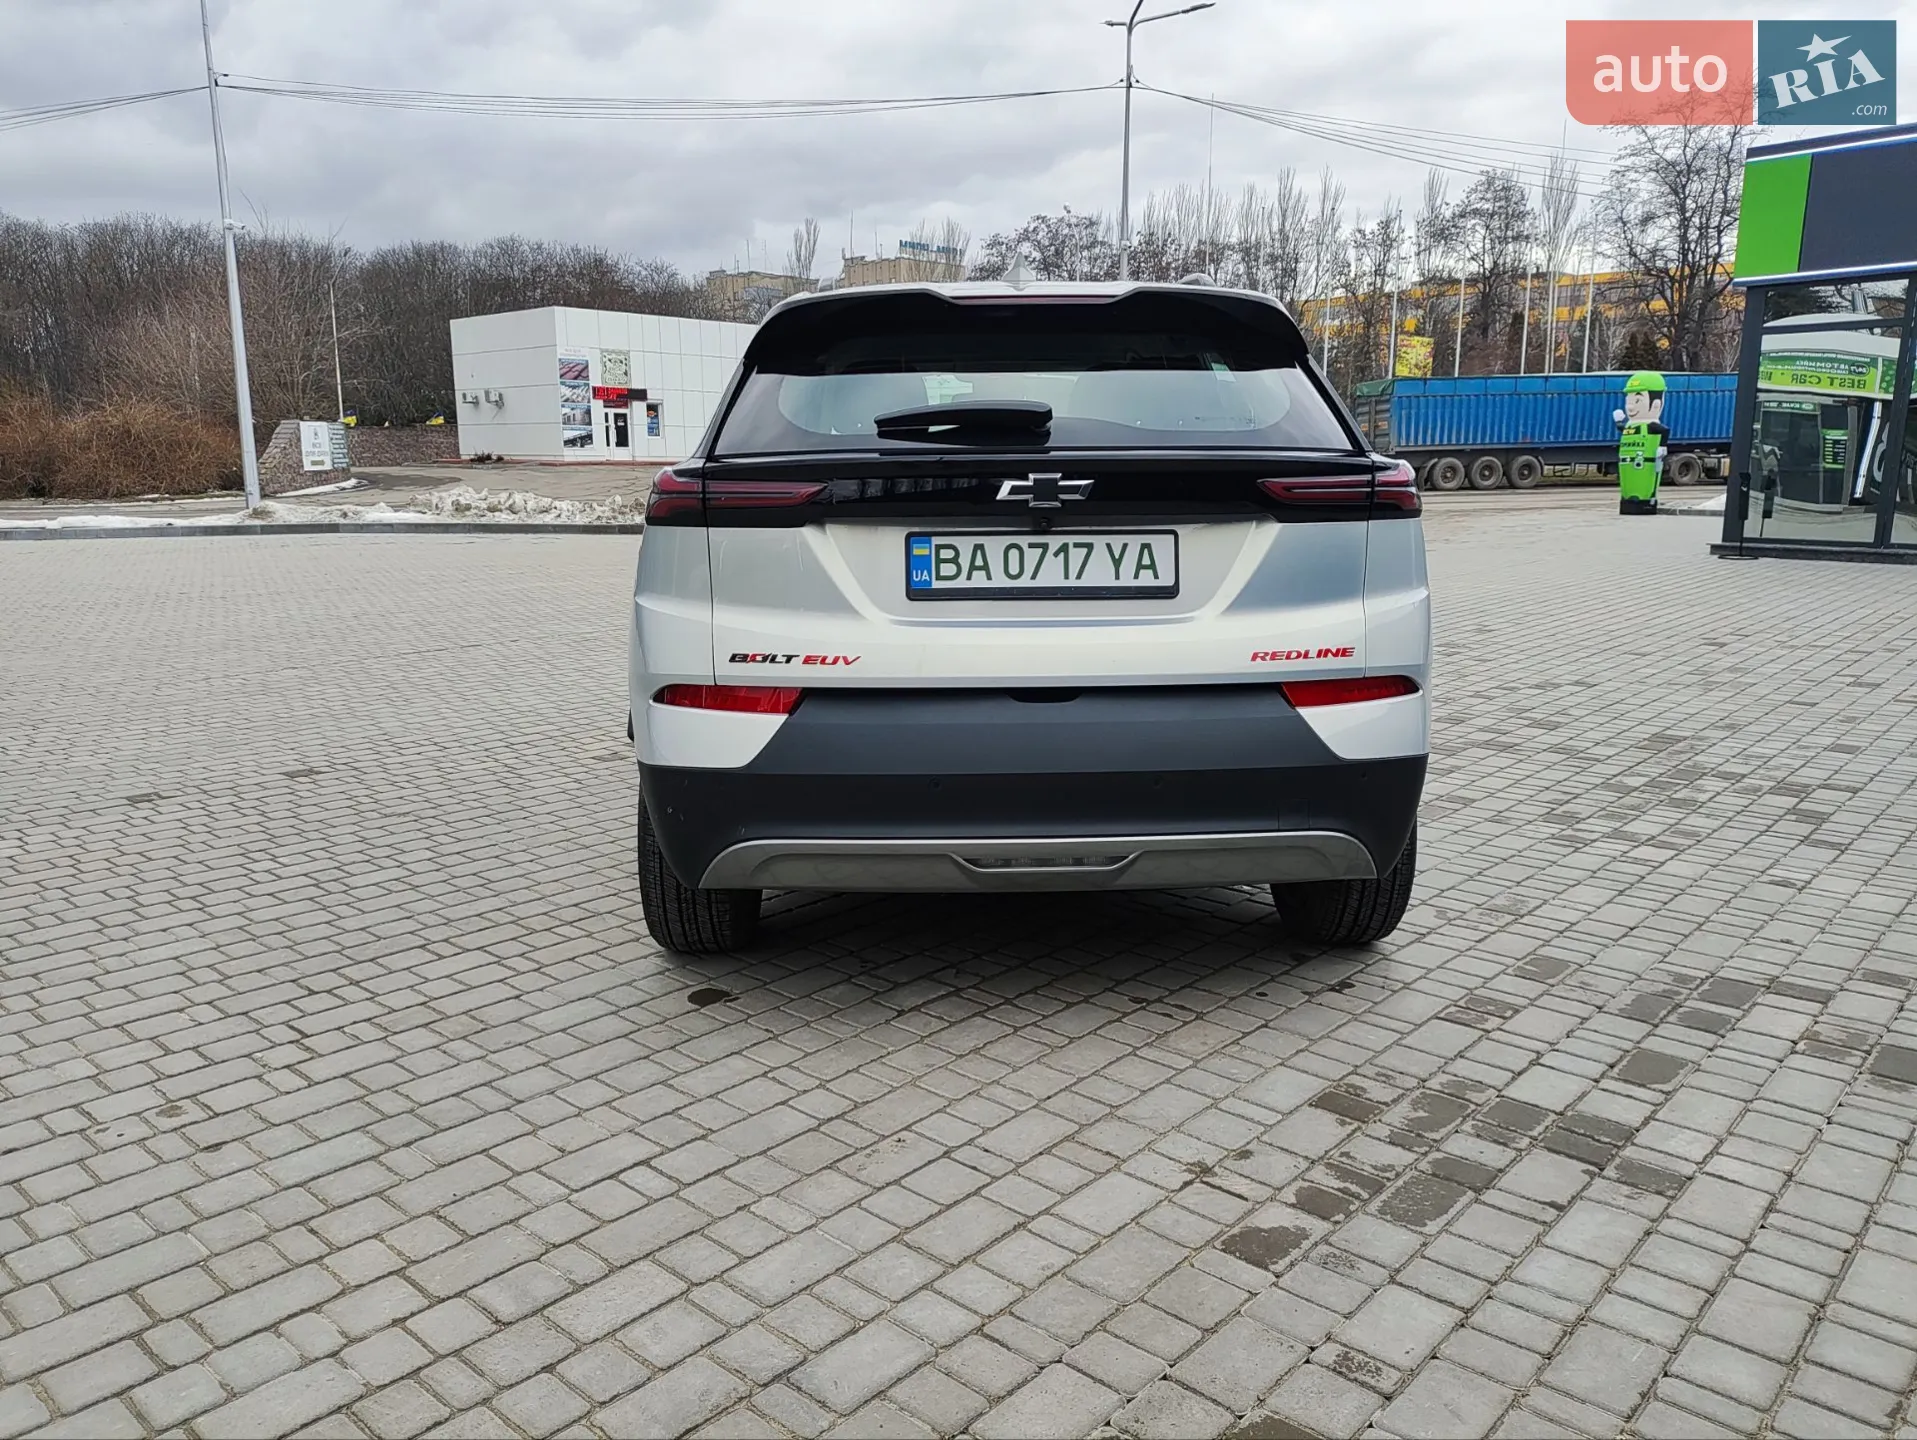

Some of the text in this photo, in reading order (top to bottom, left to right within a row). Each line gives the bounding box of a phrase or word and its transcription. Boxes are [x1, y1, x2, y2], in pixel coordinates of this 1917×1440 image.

[934, 542, 1160, 581] BA 0717 YA
[912, 570, 930, 581] UA
[728, 652, 862, 666] BOLT EUV
[1250, 646, 1356, 662] REDLINE
